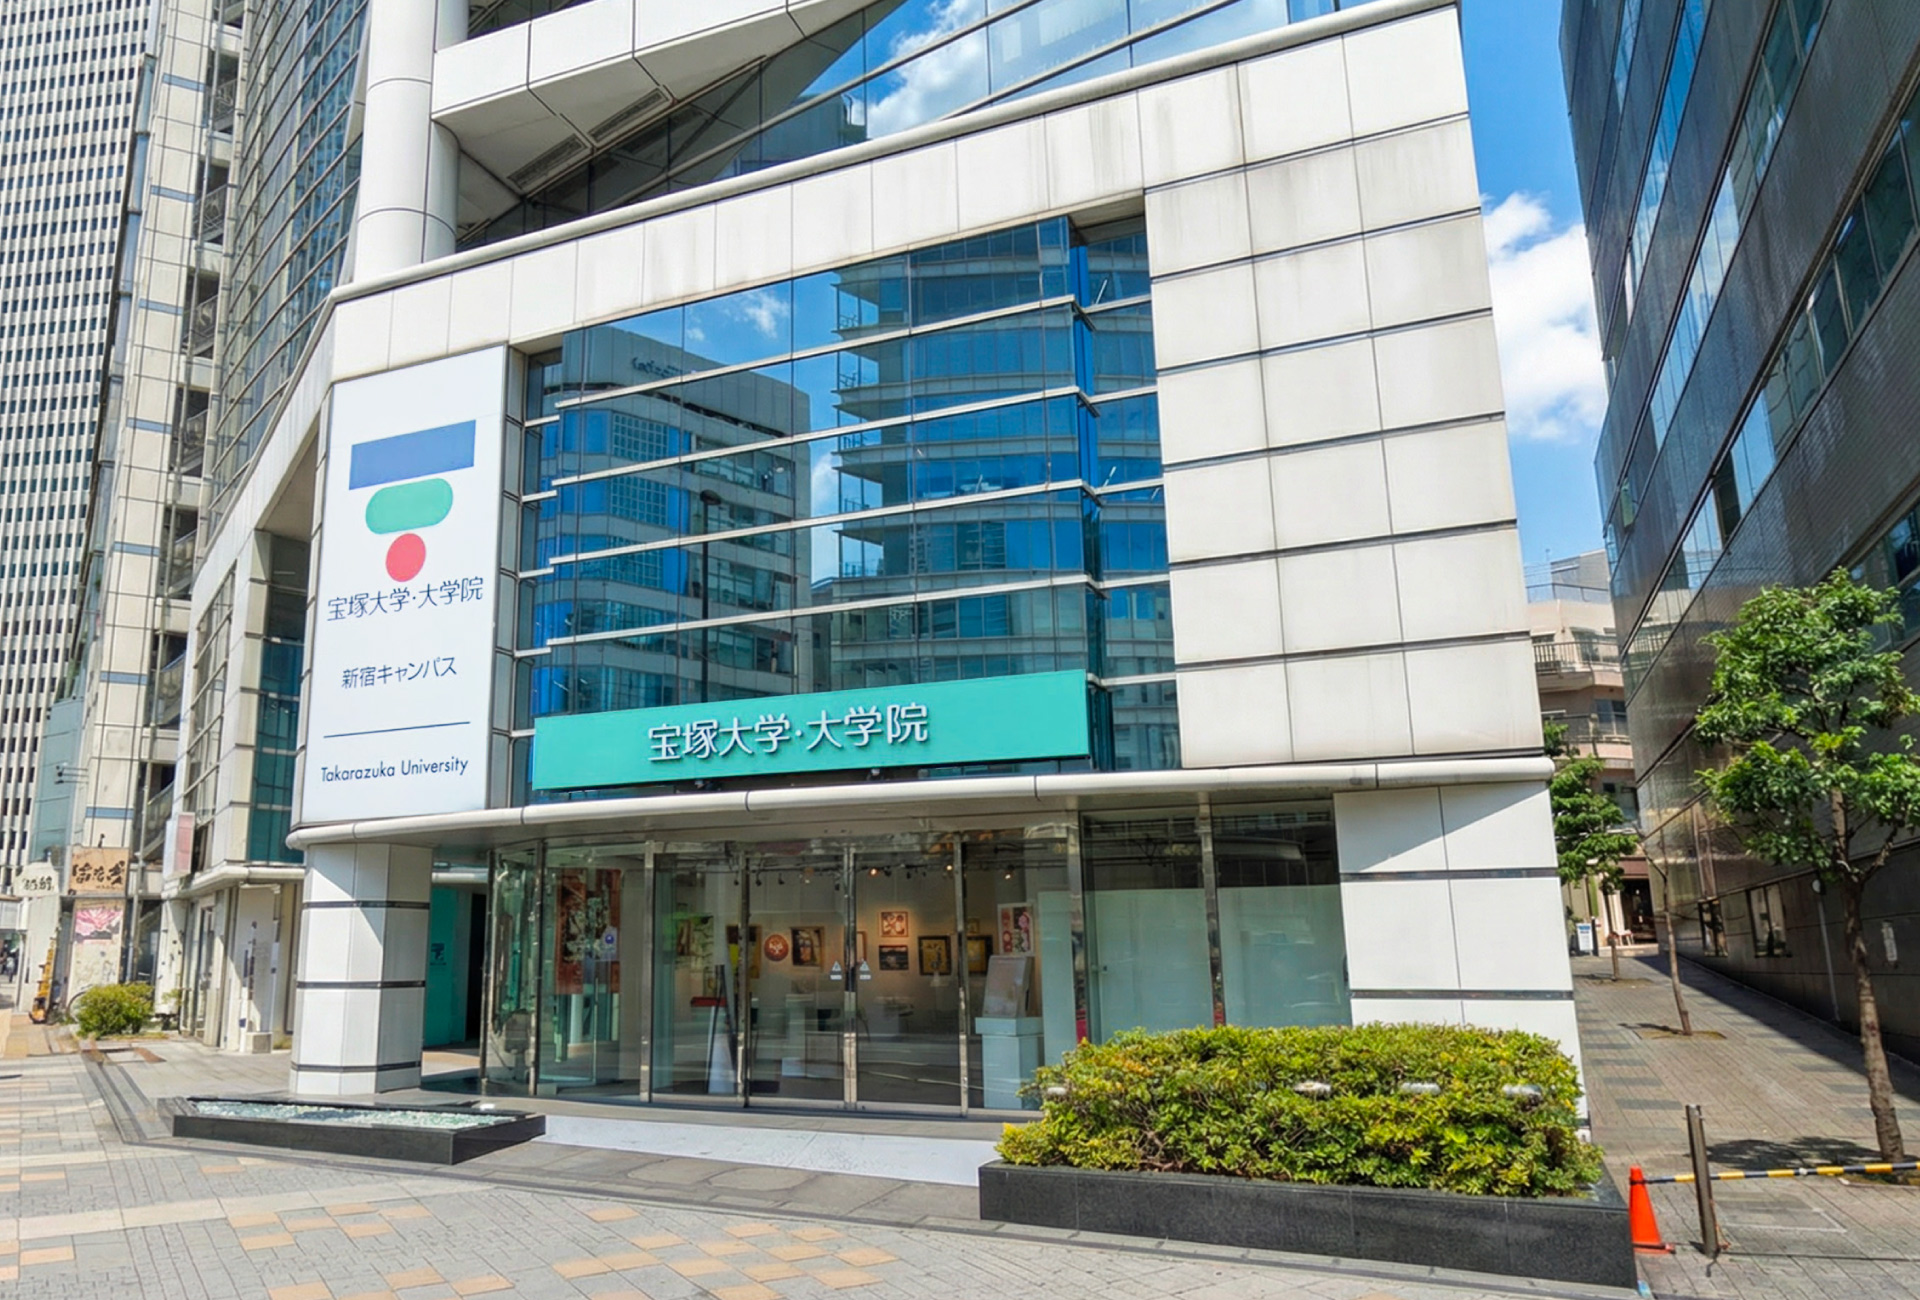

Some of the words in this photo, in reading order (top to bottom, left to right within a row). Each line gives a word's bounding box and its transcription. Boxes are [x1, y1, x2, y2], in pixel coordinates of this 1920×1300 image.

[341, 657, 457, 689] 新宿キャンパス
[321, 762, 395, 783] Takarazuka
[401, 756, 469, 777] University
